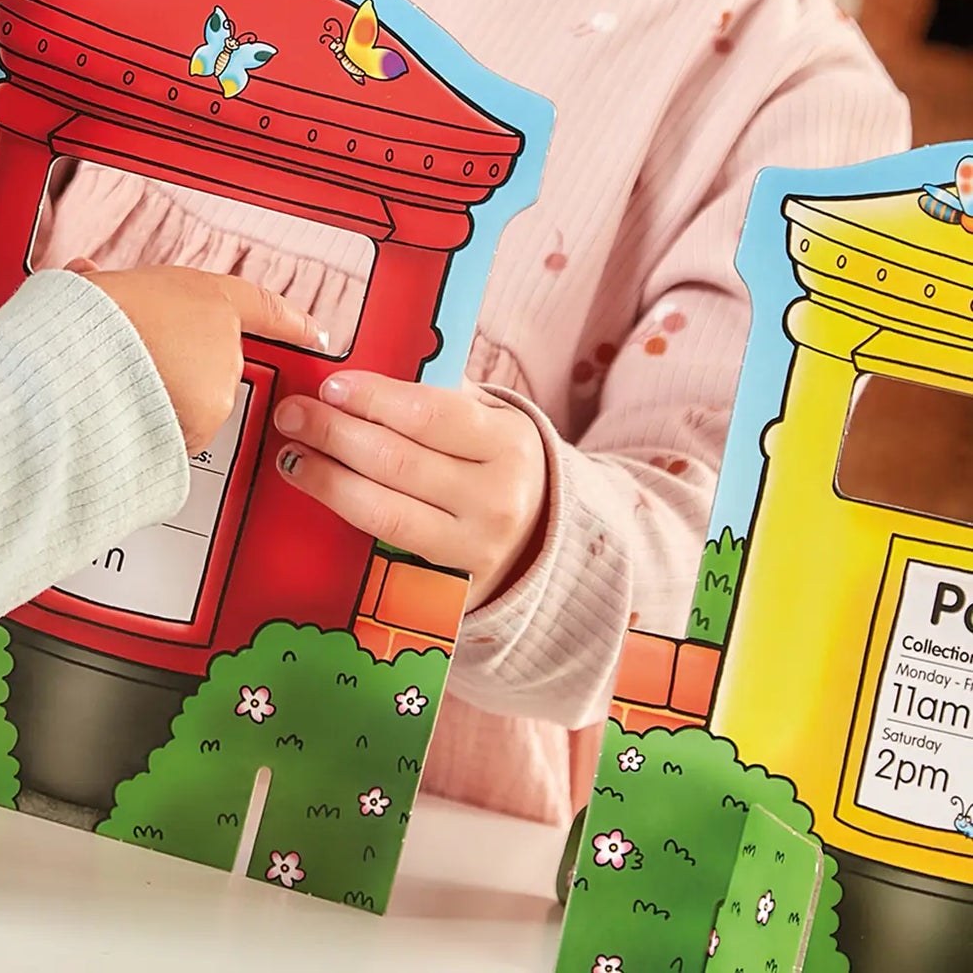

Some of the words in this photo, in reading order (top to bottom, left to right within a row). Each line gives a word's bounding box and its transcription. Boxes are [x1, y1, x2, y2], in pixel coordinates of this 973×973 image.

[895, 663, 951, 689] Monday
[893, 682, 970, 729] 11am
[882, 727, 942, 755] Saturday
[874, 748, 949, 793] 2pm
